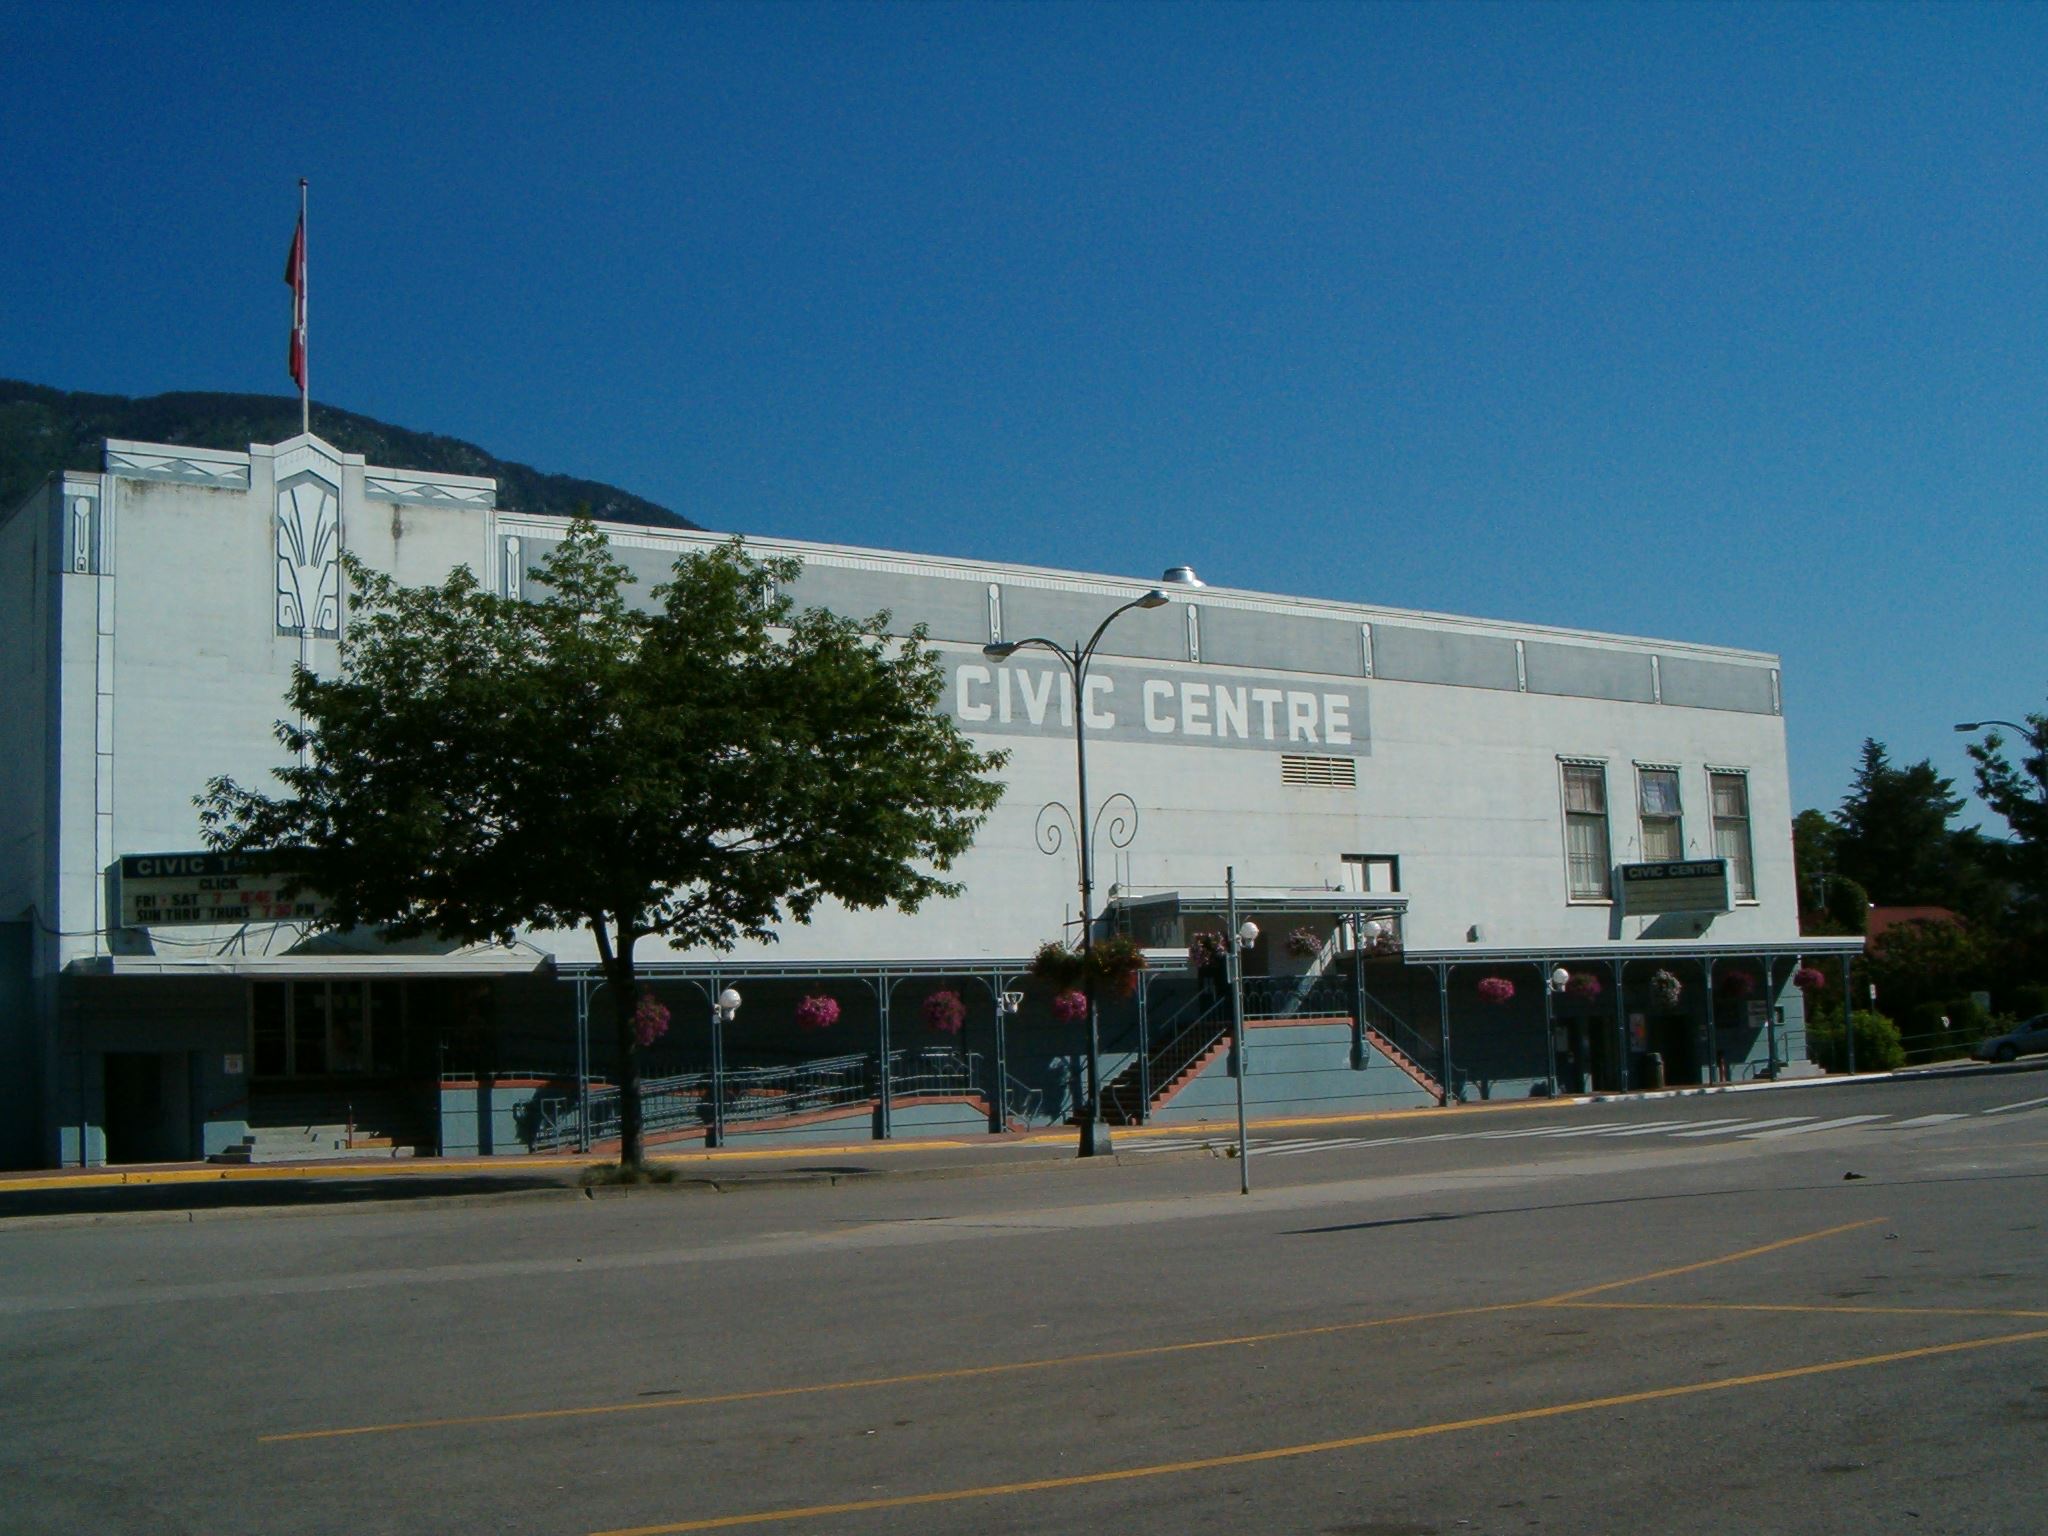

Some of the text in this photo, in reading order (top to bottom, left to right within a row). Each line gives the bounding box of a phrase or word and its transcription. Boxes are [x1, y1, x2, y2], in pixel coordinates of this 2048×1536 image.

[956, 664, 1352, 745] CIVIC CENTRE
[137, 858, 205, 875] CIVIC
[1629, 864, 1719, 878] CIVIC CENTRE
[199, 877, 239, 890] CLICK
[136, 895, 156, 907] FRI
[172, 893, 200, 906] SAT
[166, 907, 201, 921] THRU
